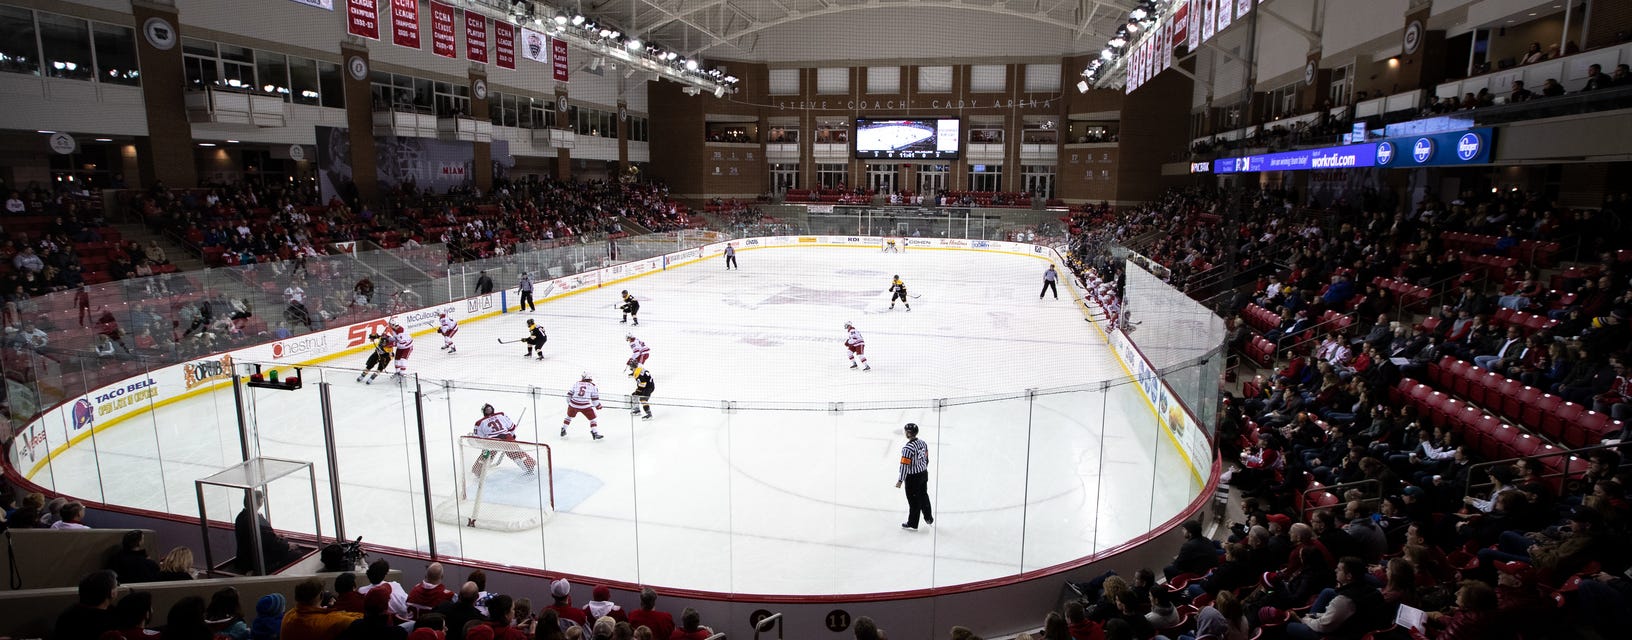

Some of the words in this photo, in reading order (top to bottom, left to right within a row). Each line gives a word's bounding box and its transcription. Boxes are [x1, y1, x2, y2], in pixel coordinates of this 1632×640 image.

[395, 0, 415, 10] CCHA
[395, 9, 416, 20] LEAGUE
[434, 10, 451, 22] CCHA
[435, 22, 452, 32] LEAGUE
[468, 17, 483, 28] CCHA
[497, 27, 512, 37] CCHA
[780, 101, 827, 110] STEVE
[932, 100, 977, 109] CADY
[994, 100, 1051, 109] ARENA
[1460, 137, 1478, 157] Kroger
[1312, 153, 1356, 168] workrdi.com
[95, 388, 125, 404] TACO
[126, 378, 157, 393] BELL
[578, 386, 587, 396] 6
[487, 418, 504, 433] 31
[829, 614, 846, 628] 11
